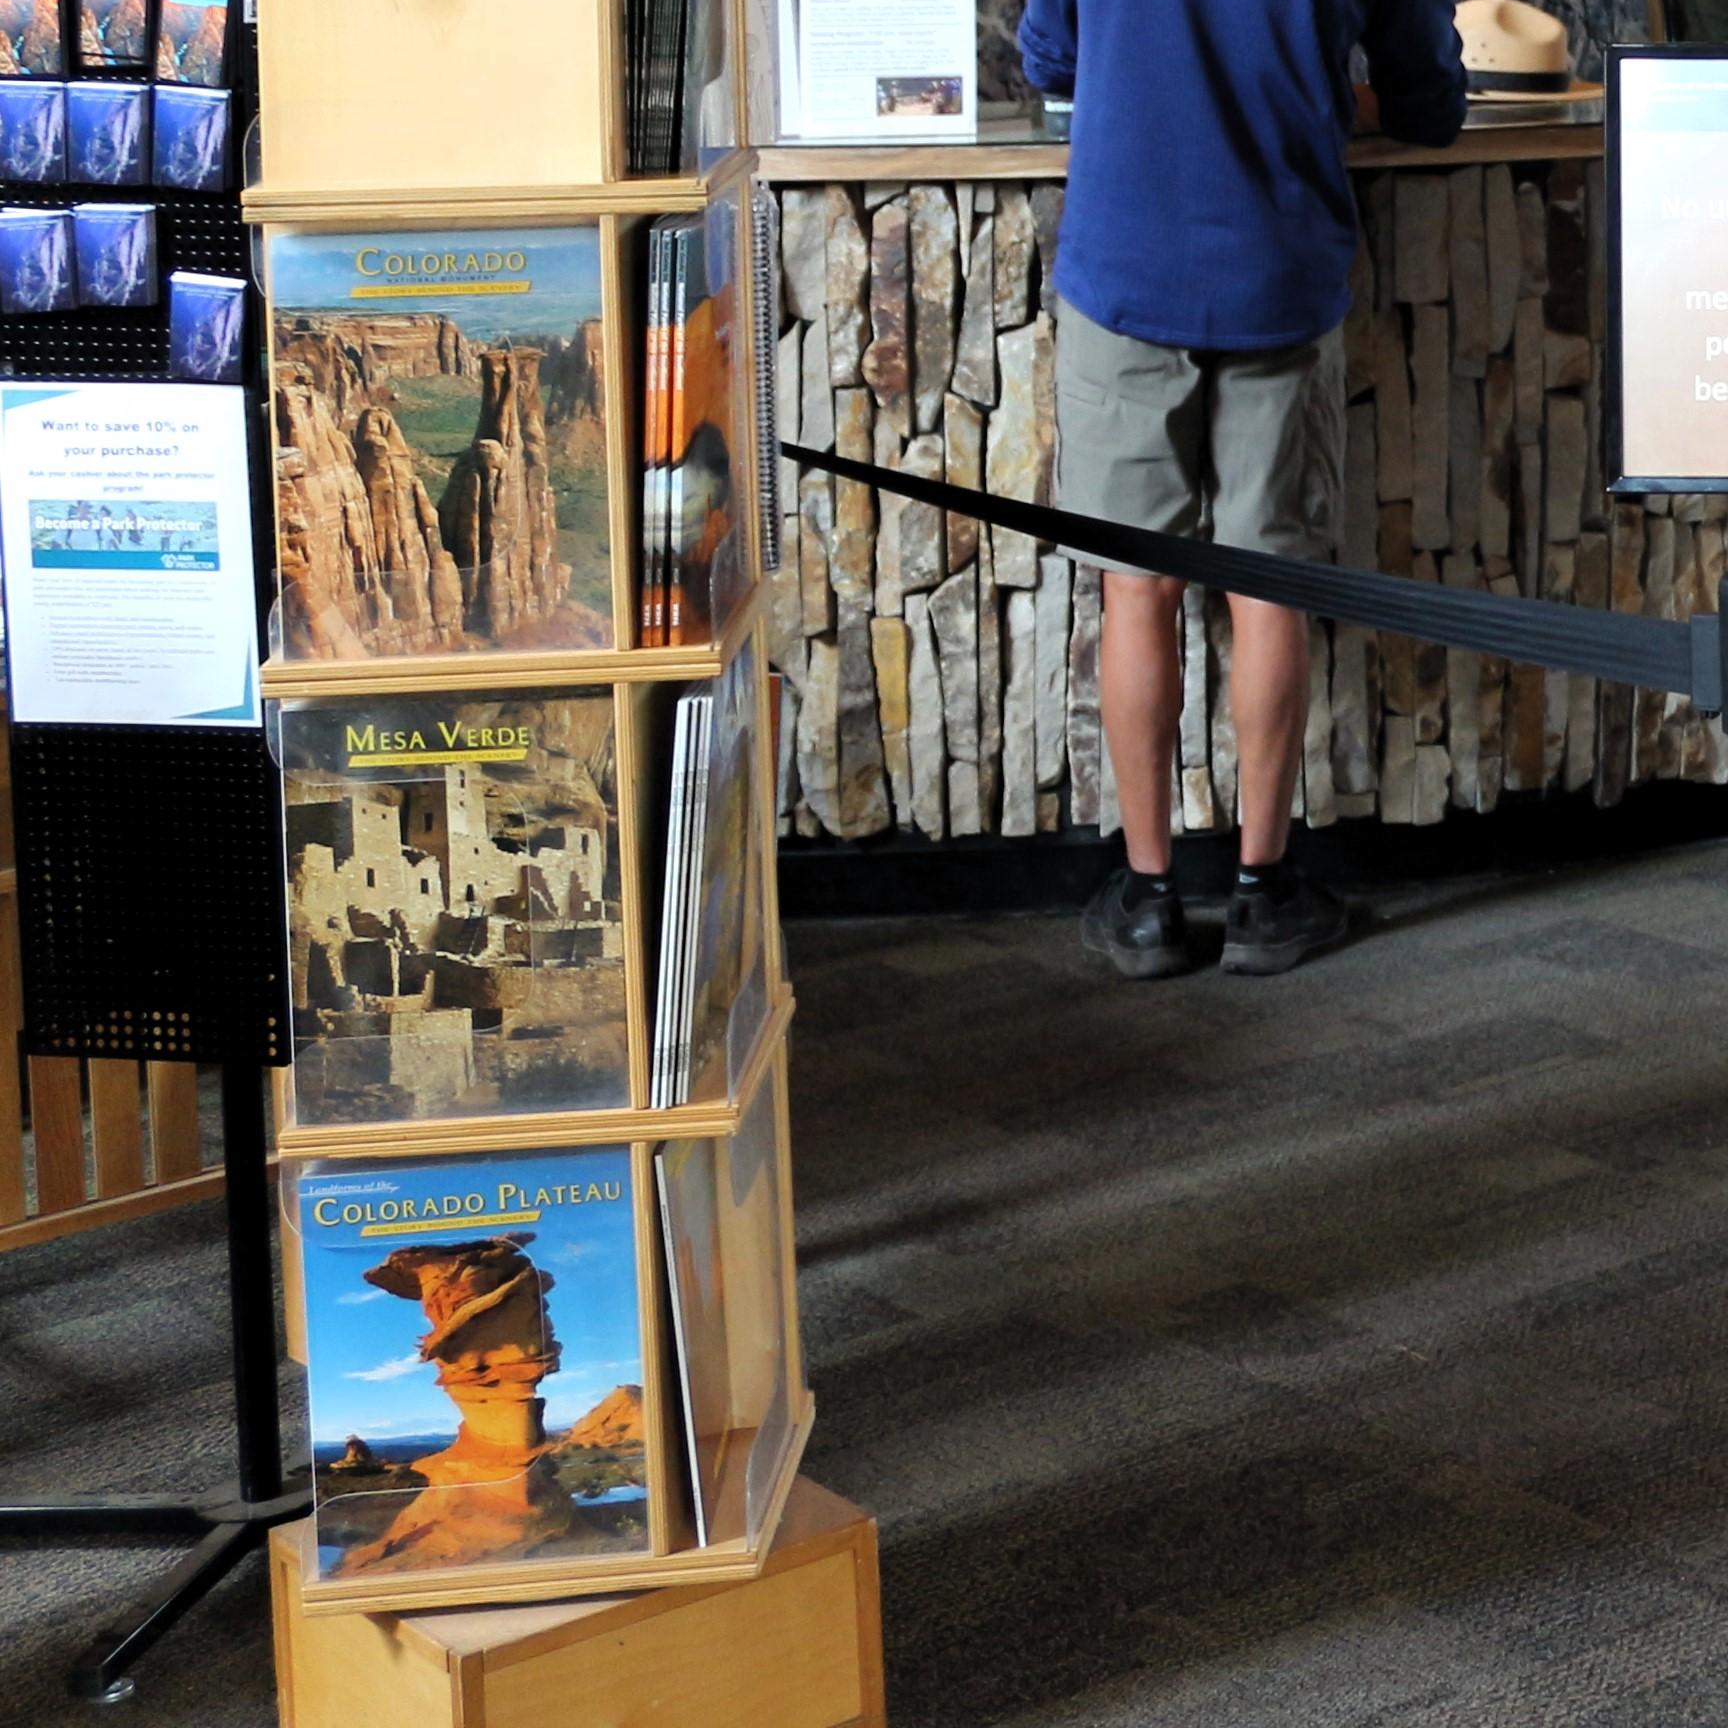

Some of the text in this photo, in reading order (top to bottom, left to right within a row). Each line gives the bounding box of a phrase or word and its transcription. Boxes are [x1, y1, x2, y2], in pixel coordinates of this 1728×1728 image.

[41, 419, 200, 433] Want to save 10% on
[63, 445, 180, 458] your purchase?
[35, 516, 203, 533] Become a Park Protector
[364, 1183, 375, 1193] of
